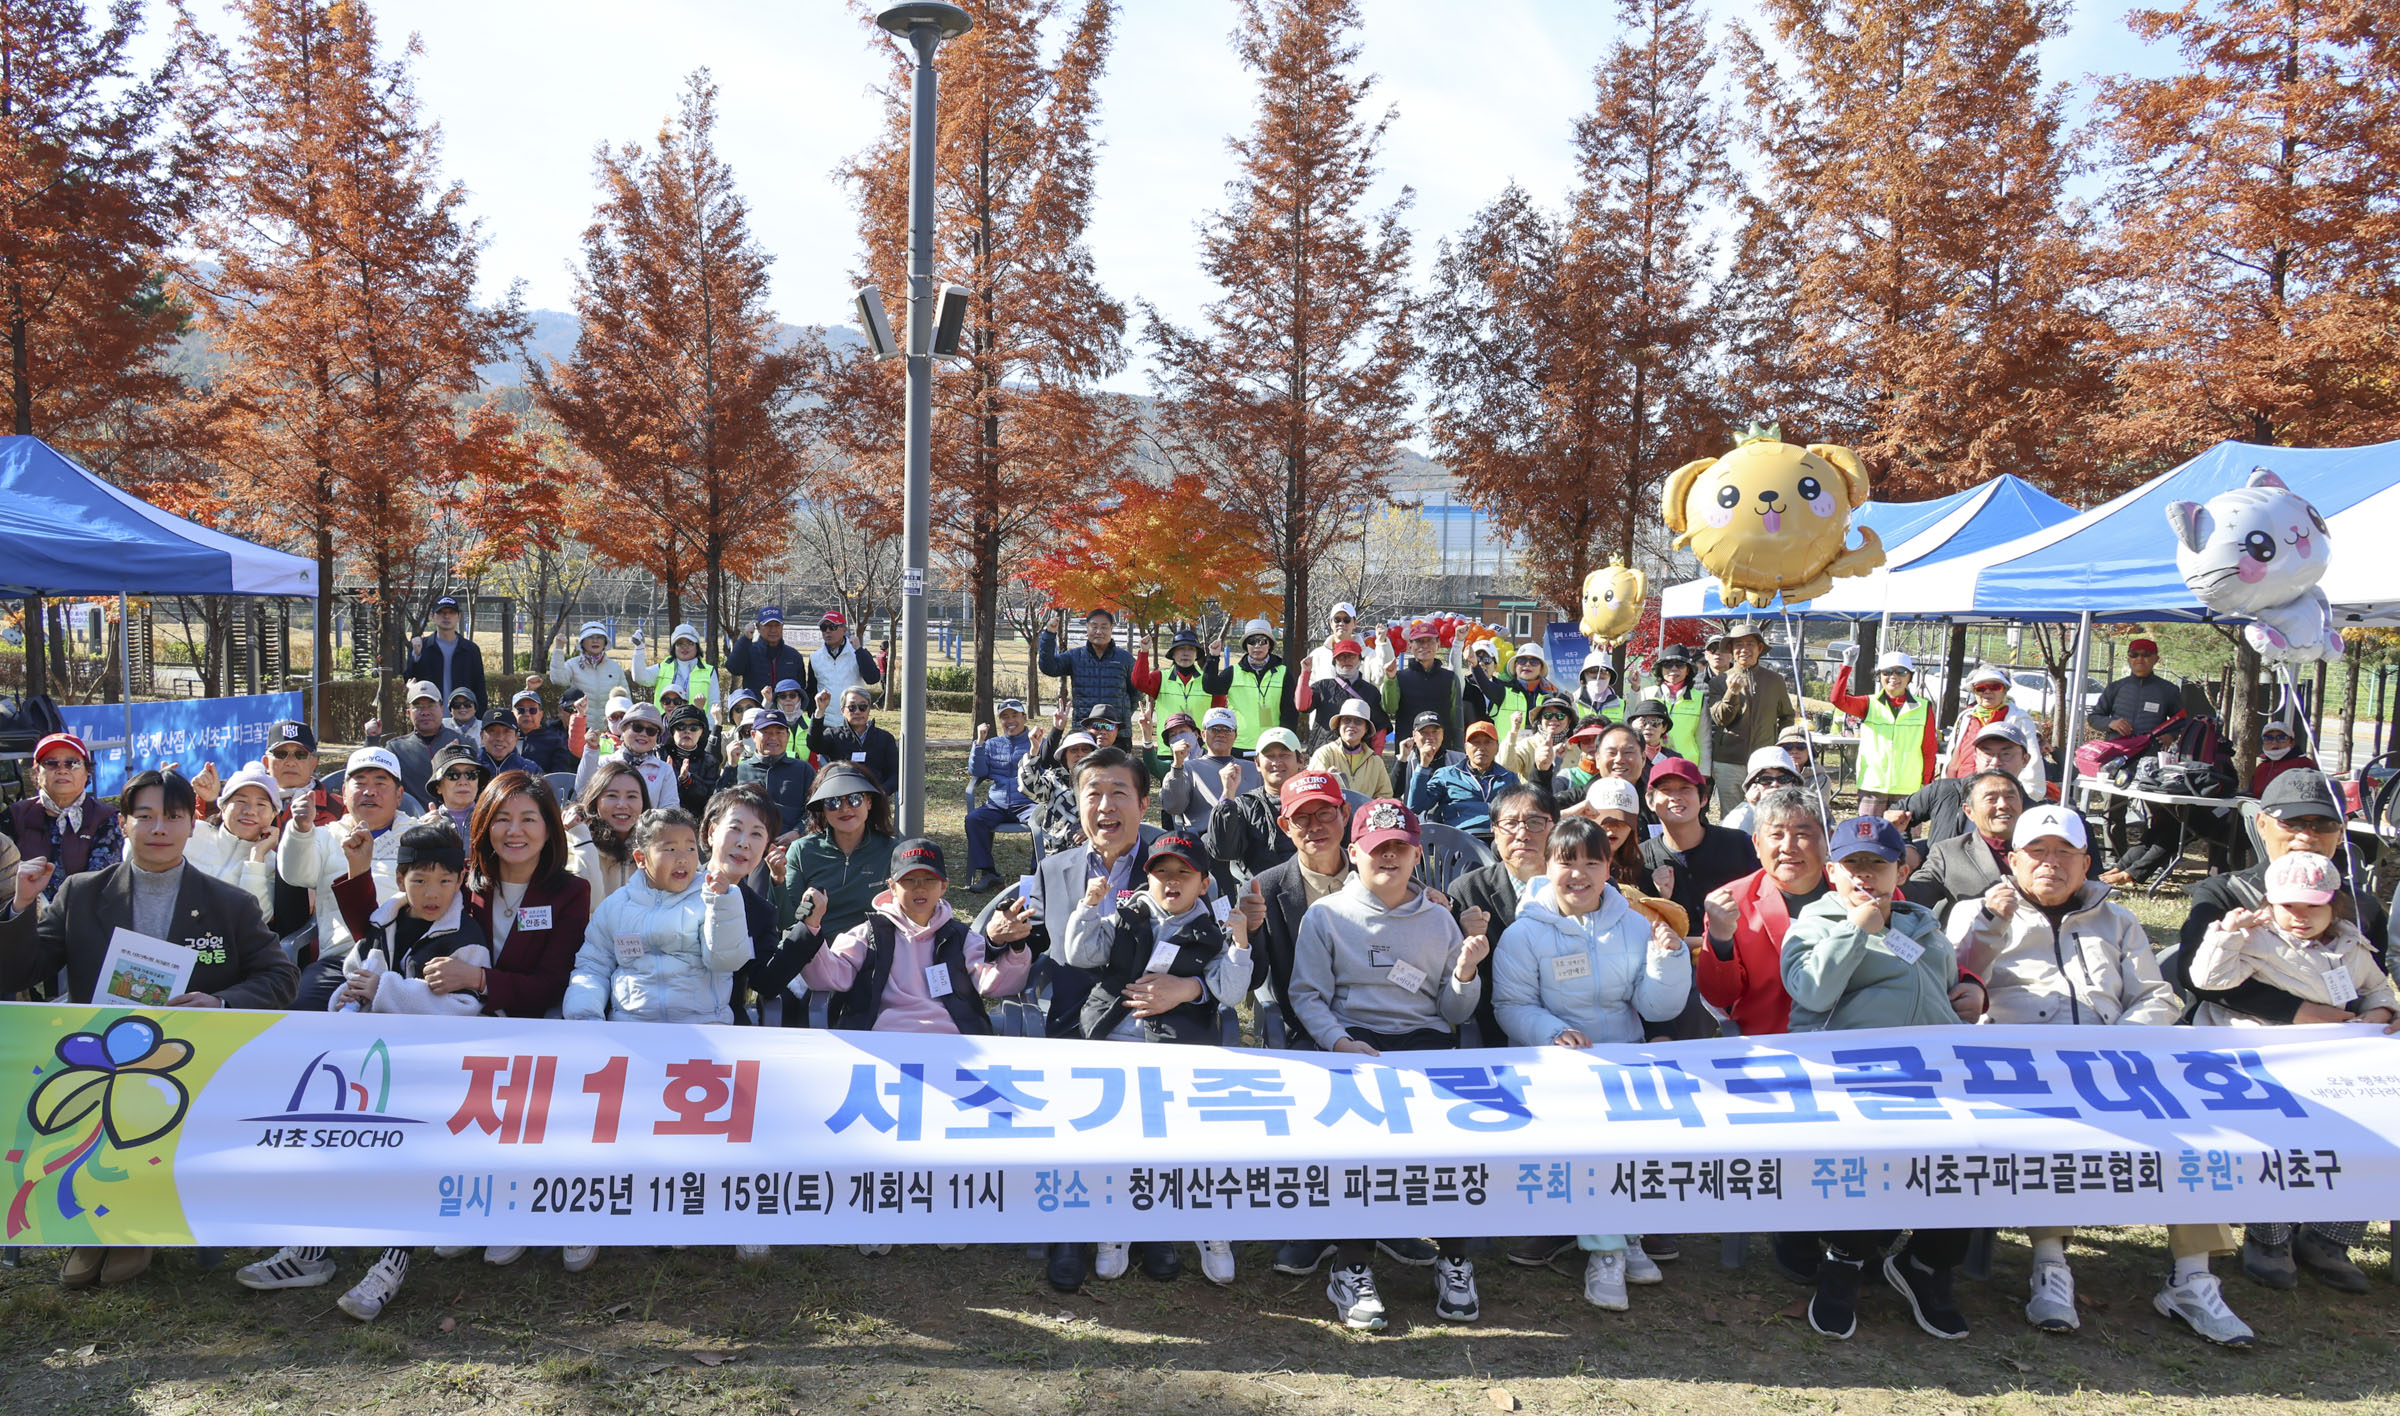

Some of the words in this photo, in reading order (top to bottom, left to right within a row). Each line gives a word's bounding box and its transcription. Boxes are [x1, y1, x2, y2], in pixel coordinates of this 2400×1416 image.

[137, 728, 185, 758] 청계산점
[198, 725, 232, 750] 서초구
[184, 936, 224, 949] 구의원
[525, 918, 548, 928] 안종숙
[446, 1055, 761, 1145] 제1회
[824, 1062, 1533, 1142] 서초가족사랑
[1588, 1044, 2310, 1129] 파크골프대회
[257, 1128, 307, 1148] 서초
[311, 1129, 404, 1148] SEOCHO
[439, 1174, 493, 1217] 일시
[530, 1173, 634, 1216] 2025년
[649, 1171, 706, 1216] 11월
[720, 1171, 832, 1216] 15일(토)
[848, 1170, 933, 1214] 개회식
[948, 1169, 1004, 1213] 11시
[1034, 1169, 1090, 1212] 장소
[1128, 1164, 1331, 1211] 청계산수변공원
[1343, 1162, 1490, 1208] 파크골프장
[1516, 1161, 1572, 1204] 주최
[1610, 1157, 1783, 1203] 서초구체육회
[1811, 1156, 1868, 1199] 주관
[1905, 1150, 2164, 1198] 서초구파크골프협회
[2178, 1149, 2243, 1193] 후원:
[2258, 1148, 2342, 1191] 서초구
